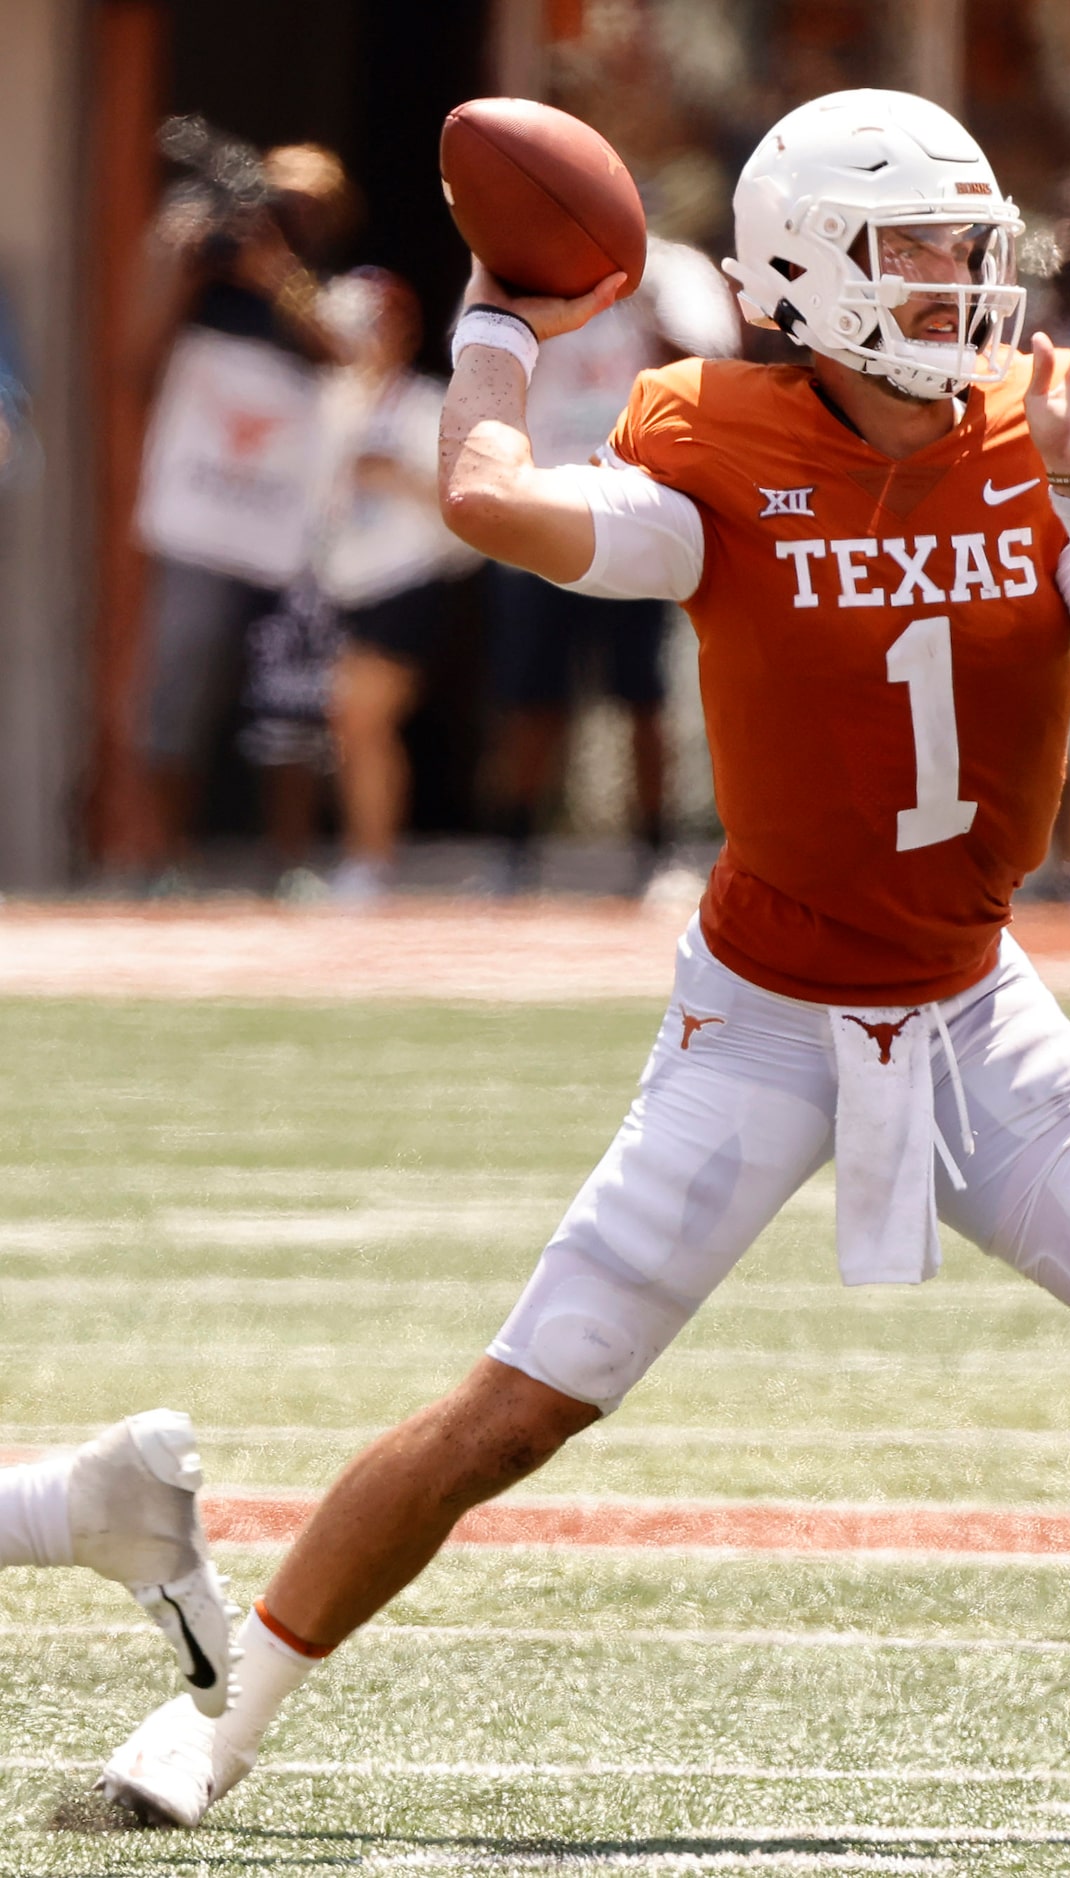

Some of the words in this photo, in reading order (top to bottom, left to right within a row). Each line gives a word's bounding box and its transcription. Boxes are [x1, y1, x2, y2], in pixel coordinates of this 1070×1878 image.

[759, 487, 816, 517] XII
[775, 527, 1038, 608] TEXAS
[886, 615, 978, 852] 1
